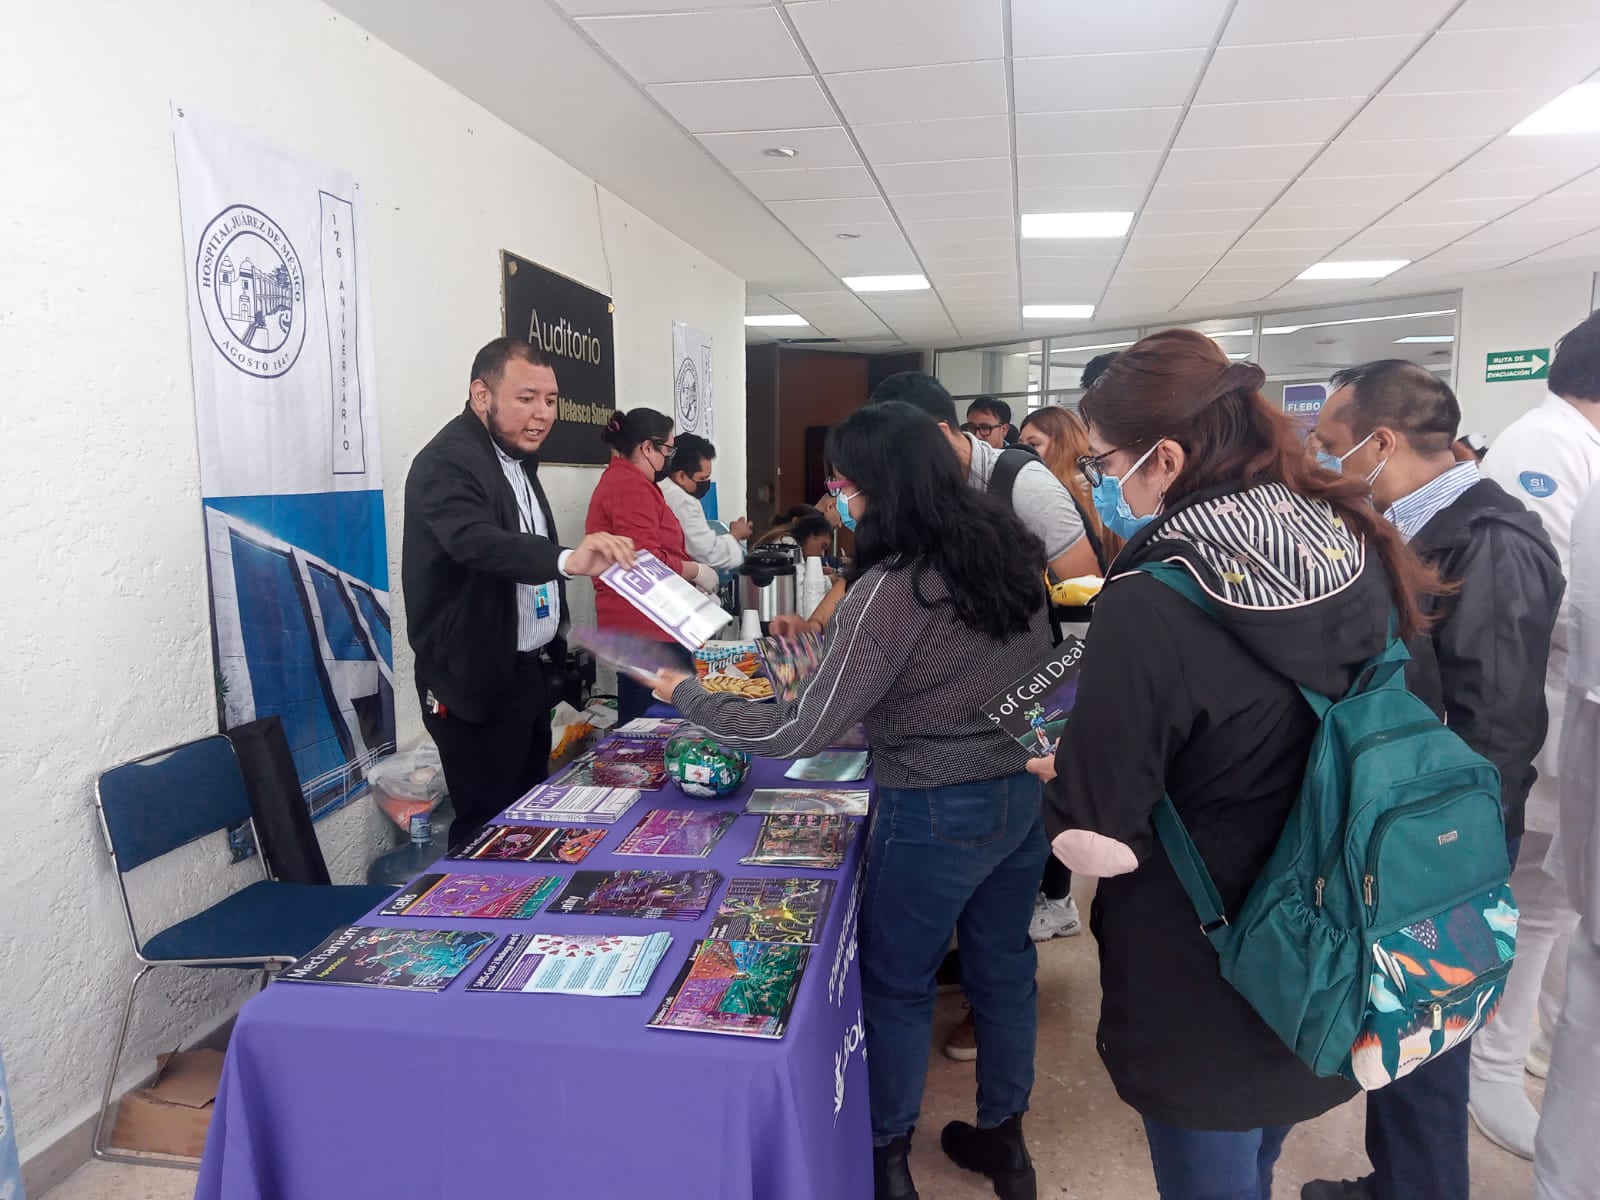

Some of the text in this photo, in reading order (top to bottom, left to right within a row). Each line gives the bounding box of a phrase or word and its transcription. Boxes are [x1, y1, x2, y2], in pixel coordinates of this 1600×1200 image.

[203, 210, 302, 303] HOSPITAL JUÁREZ DE MÉXICO
[528, 308, 600, 365] Auditorio
[222, 339, 269, 371] AGOSTO
[338, 279, 350, 451] ANIVERSARIO
[1493, 354, 1525, 364] RUTA DE
[558, 396, 591, 424] Velasco
[1287, 402, 1321, 412] FLEBO
[705, 652, 745, 673] Tender
[1000, 693, 1019, 715] of
[1016, 672, 1052, 700] Cell
[391, 894, 418, 910] cells
[286, 925, 364, 978] Mechanism
